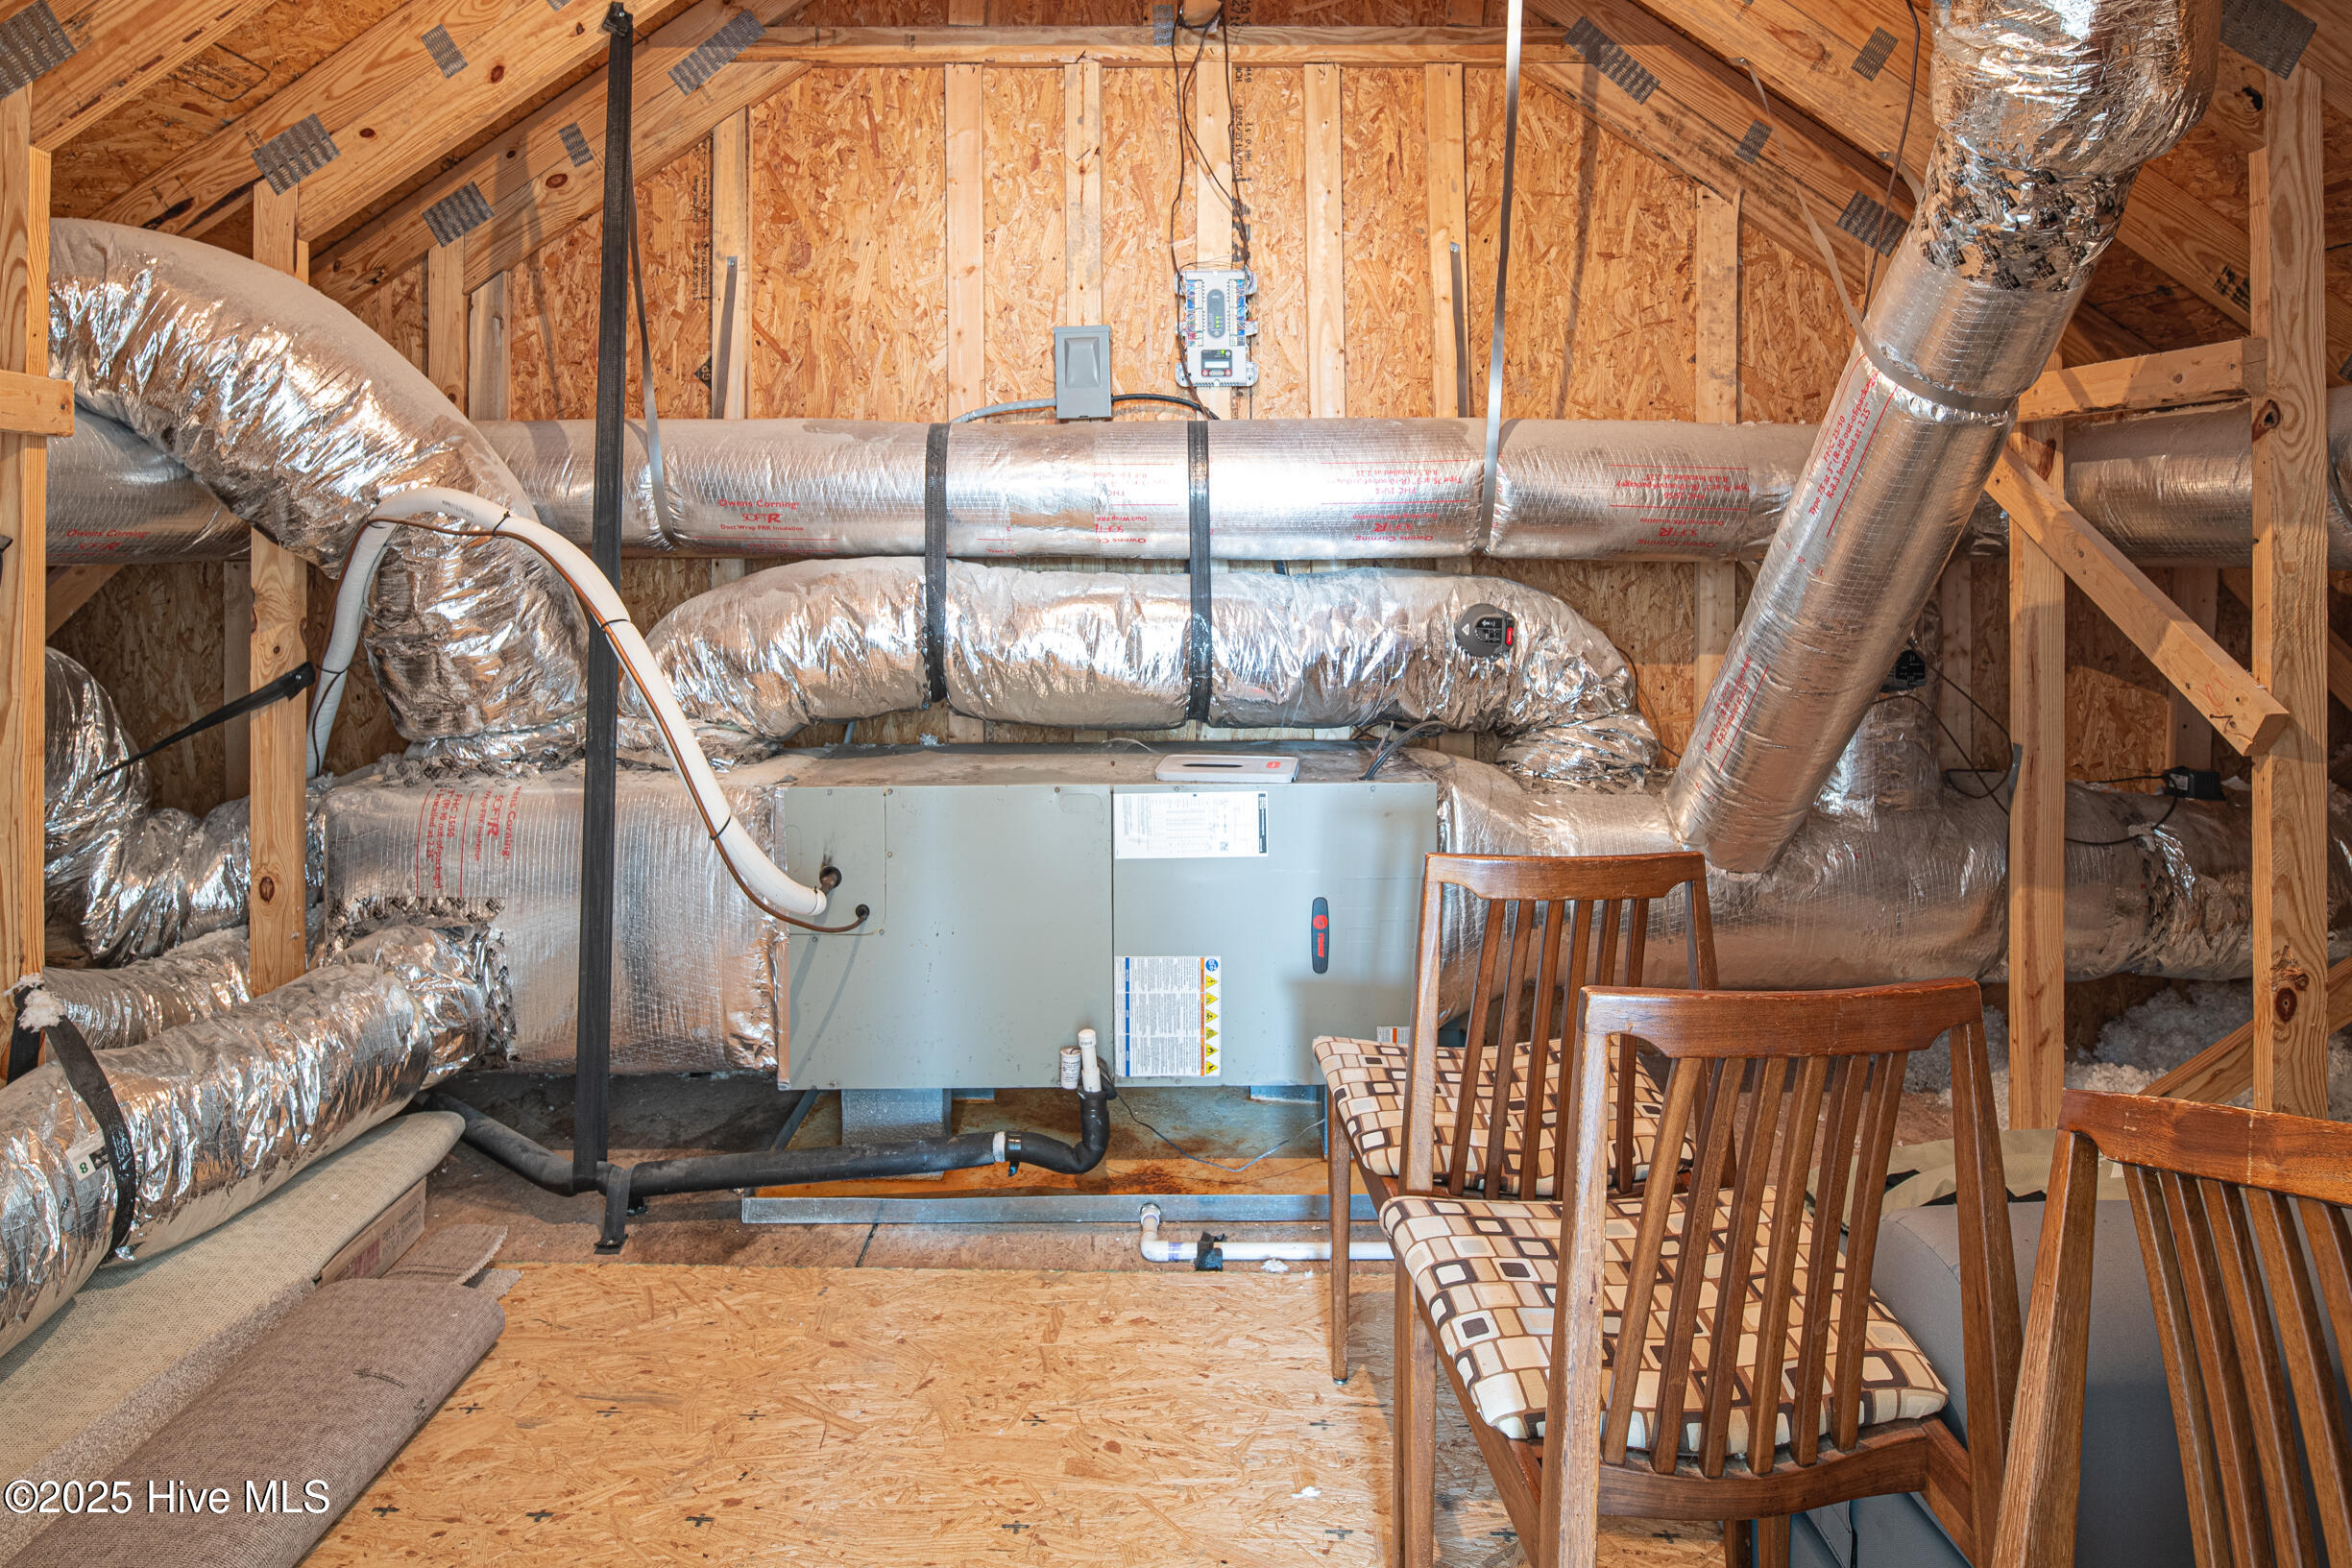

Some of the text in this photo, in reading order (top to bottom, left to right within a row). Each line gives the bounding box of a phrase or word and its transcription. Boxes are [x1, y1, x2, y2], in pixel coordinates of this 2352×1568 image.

[1823, 416, 1845, 462] FHC 25/50
[1836, 440, 1857, 476] Installed
[1854, 428, 1862, 439] at
[718, 499, 753, 508] Owens
[427, 830, 434, 838] at
[447, 794, 463, 837] FHC 25/50
